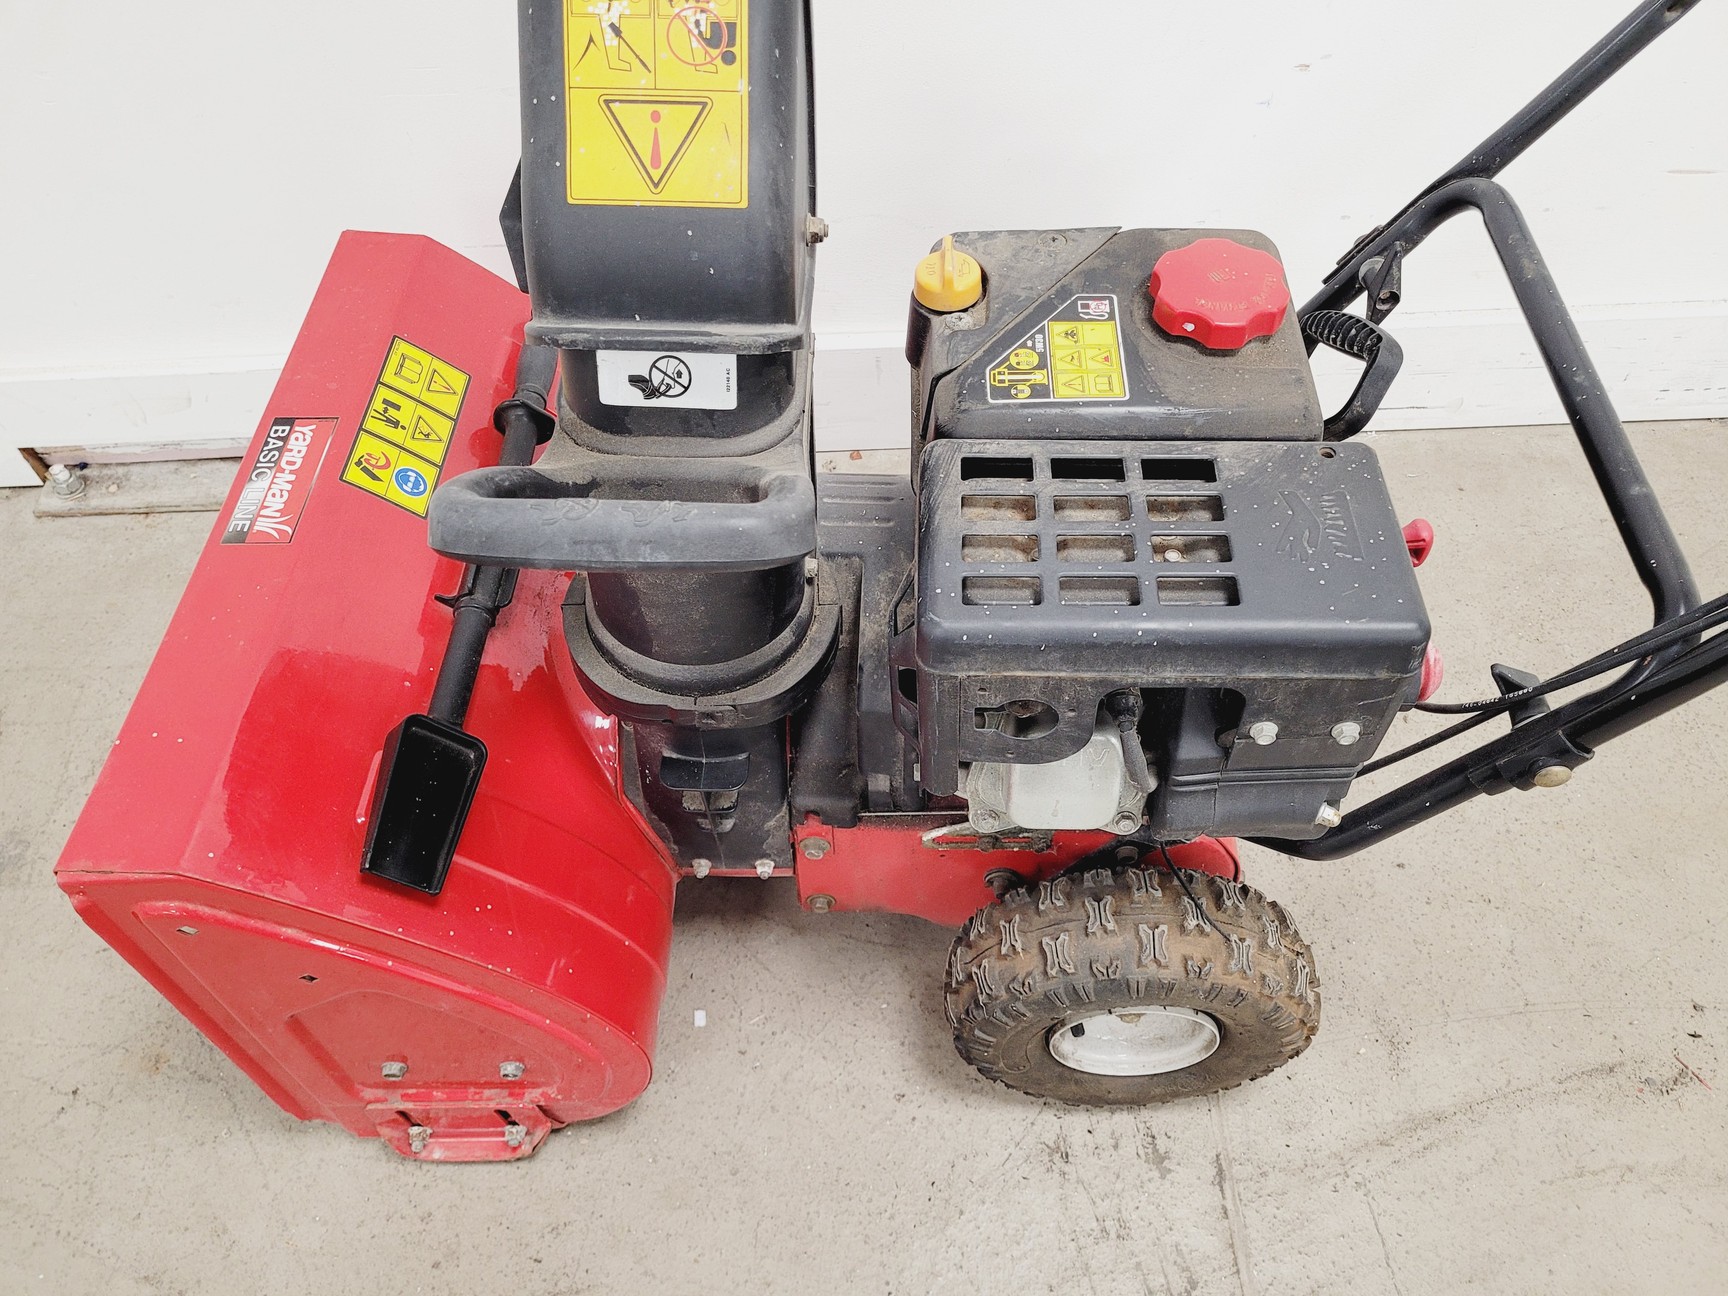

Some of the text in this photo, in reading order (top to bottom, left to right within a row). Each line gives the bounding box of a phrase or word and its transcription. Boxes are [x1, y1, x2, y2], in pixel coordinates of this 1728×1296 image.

[1035, 334, 1044, 353] 5W30
[228, 425, 291, 532] BASIC LINE
